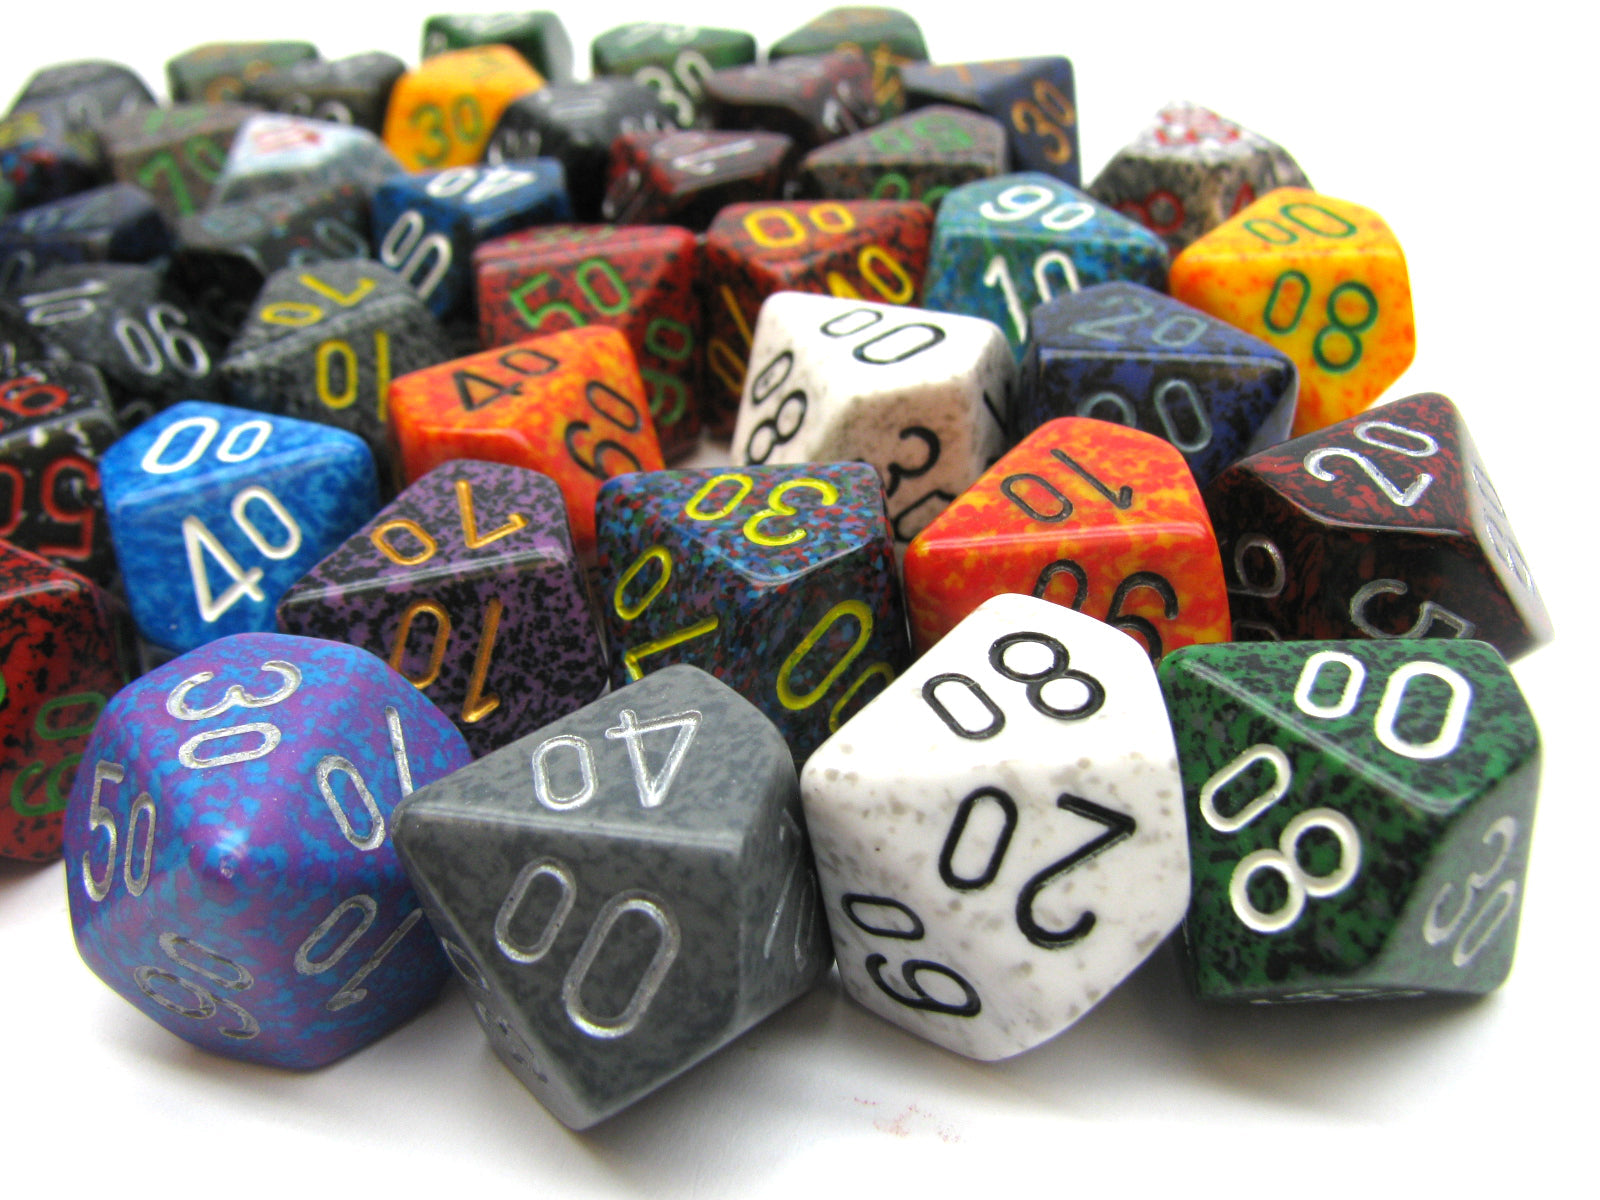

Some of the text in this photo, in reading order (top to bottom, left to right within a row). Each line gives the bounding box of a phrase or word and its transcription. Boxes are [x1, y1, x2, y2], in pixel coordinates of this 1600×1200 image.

[408, 94, 484, 168] 30
[1010, 78, 1075, 165] 30
[743, 203, 855, 248] 00
[979, 184, 1095, 232] 90
[1242, 202, 1358, 246] 00
[259, 273, 376, 327] 70
[510, 257, 633, 329] 50
[820, 307, 947, 365] 00
[984, 250, 1082, 344] 10
[1069, 294, 1207, 348] 20
[1262, 269, 1380, 375] 80
[453, 349, 559, 412] 40
[745, 349, 807, 466] 80
[140, 416, 272, 474] 00
[564, 380, 643, 480] 60
[1303, 421, 1439, 507] 20
[370, 479, 529, 567] 70
[684, 473, 839, 546] 30
[1001, 449, 1133, 524] 10
[182, 485, 302, 623] 40
[389, 599, 501, 723] 10
[922, 631, 1107, 740] 80
[1293, 650, 1473, 760] 00
[166, 659, 303, 769] 30
[531, 709, 702, 811] 40
[82, 759, 157, 902] 50
[938, 785, 1137, 950] 20
[1199, 742, 1363, 934] 80
[1422, 815, 1518, 968] 30
[293, 894, 424, 1012] 10
[494, 855, 682, 1040] 00
